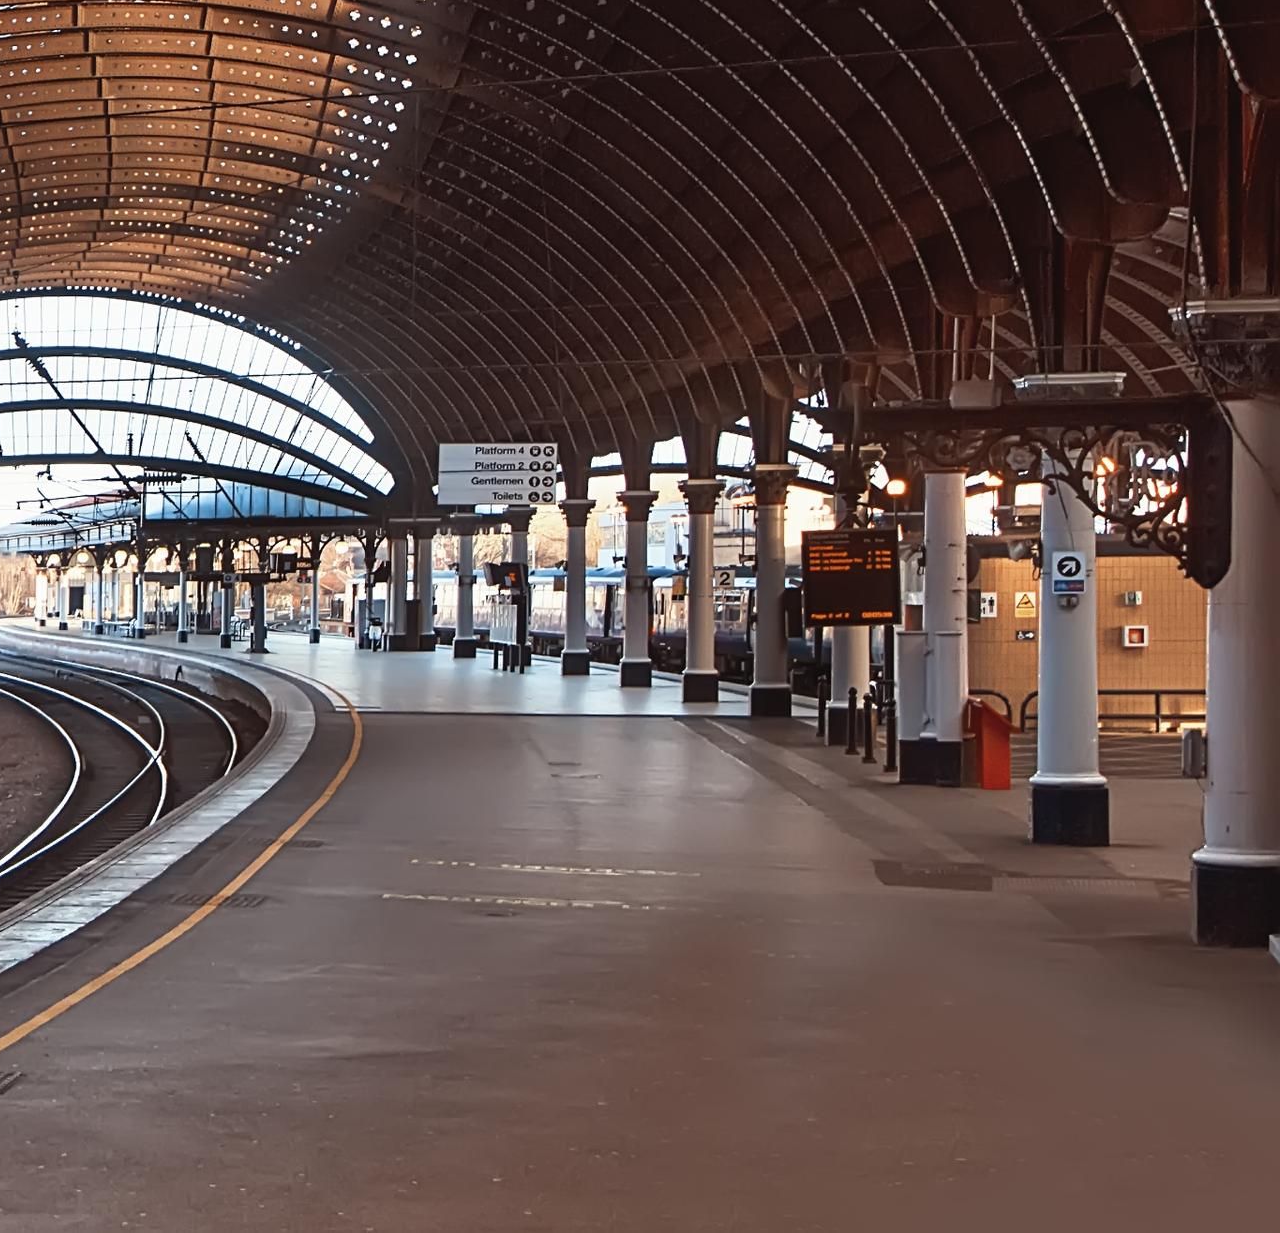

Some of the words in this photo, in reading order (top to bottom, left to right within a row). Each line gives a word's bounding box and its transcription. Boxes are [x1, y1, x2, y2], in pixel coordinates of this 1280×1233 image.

[475, 446, 516, 455] Platform
[518, 446, 525, 455] 4
[474, 461, 516, 470] Platform
[518, 461, 525, 470] 2
[471, 476, 524, 485] Gentlemen
[492, 491, 524, 500] Toilets
[719, 571, 731, 586] 2
